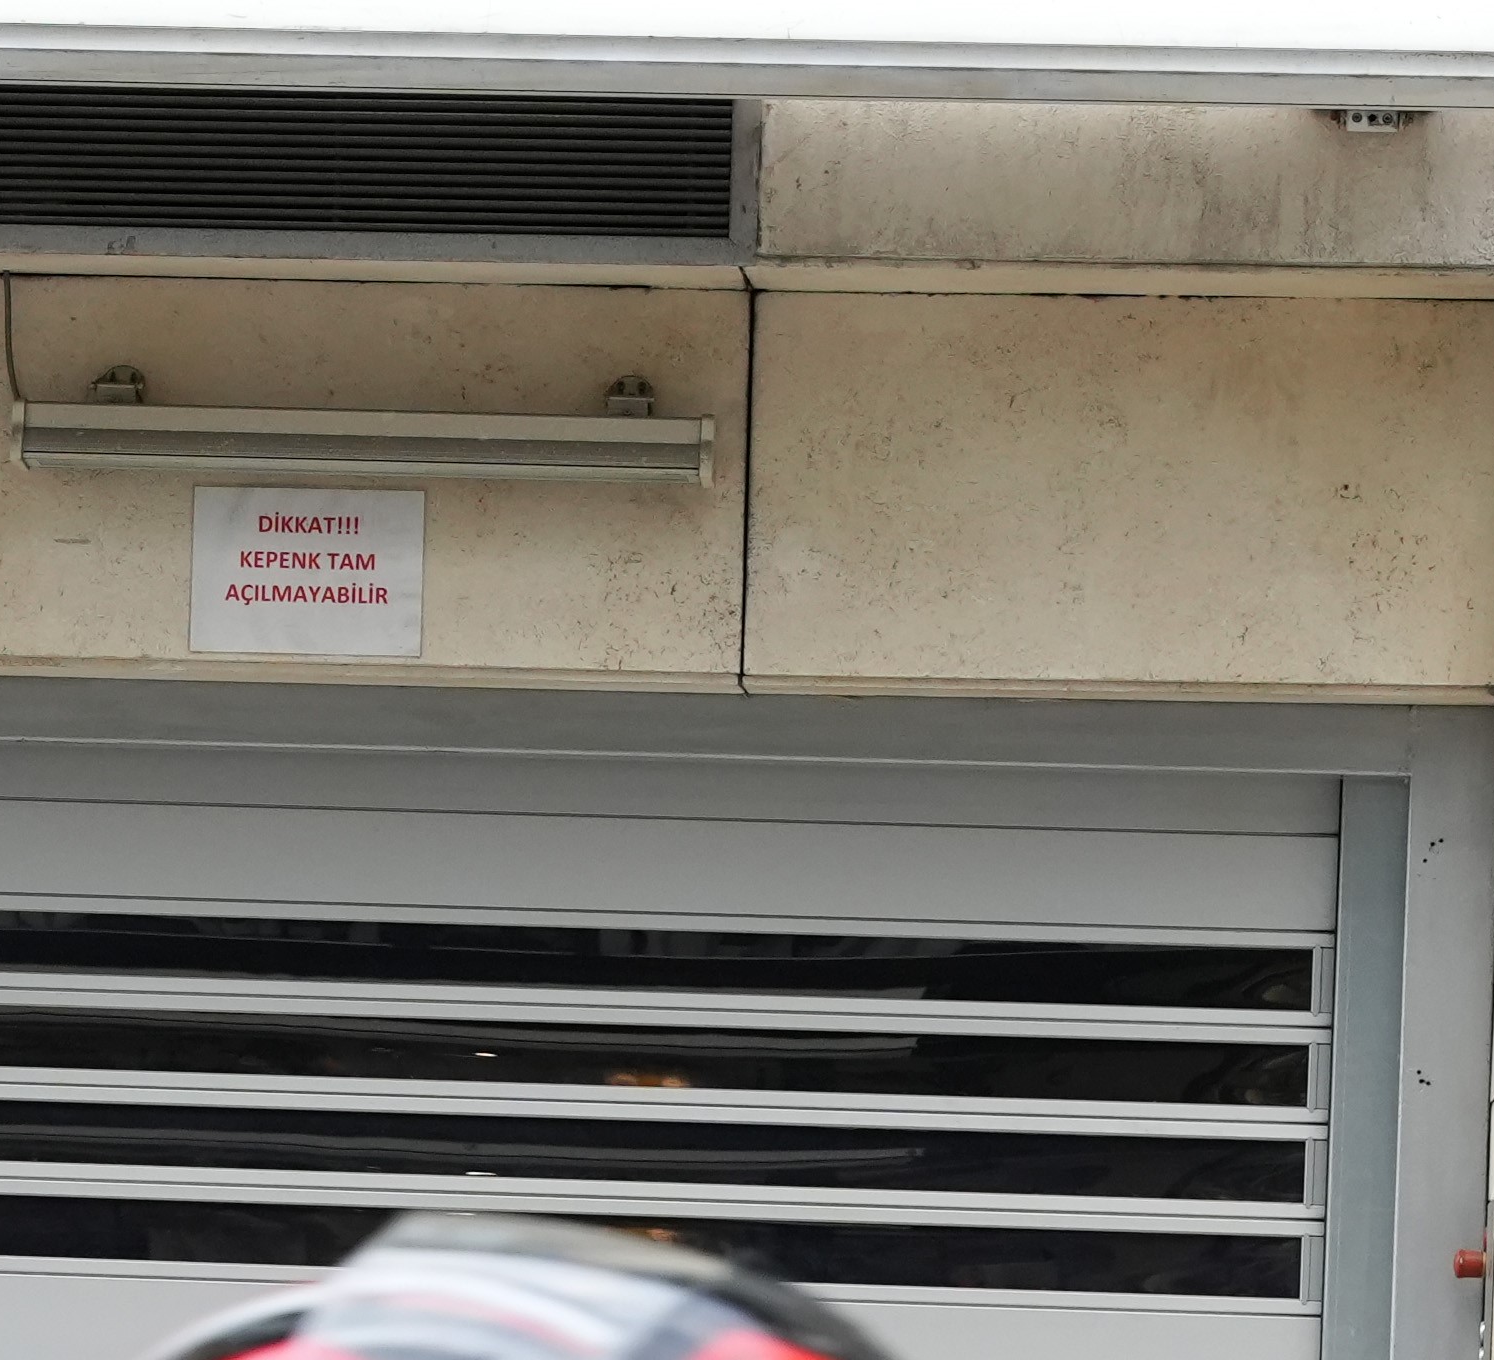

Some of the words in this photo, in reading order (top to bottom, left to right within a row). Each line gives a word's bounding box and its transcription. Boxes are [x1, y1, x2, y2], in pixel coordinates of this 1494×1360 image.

[258, 512, 359, 534] DİKKAT!!!
[240, 550, 321, 570] KEPENK
[327, 552, 376, 571] TAM
[225, 583, 388, 606] AÇILMAYABİLİR
